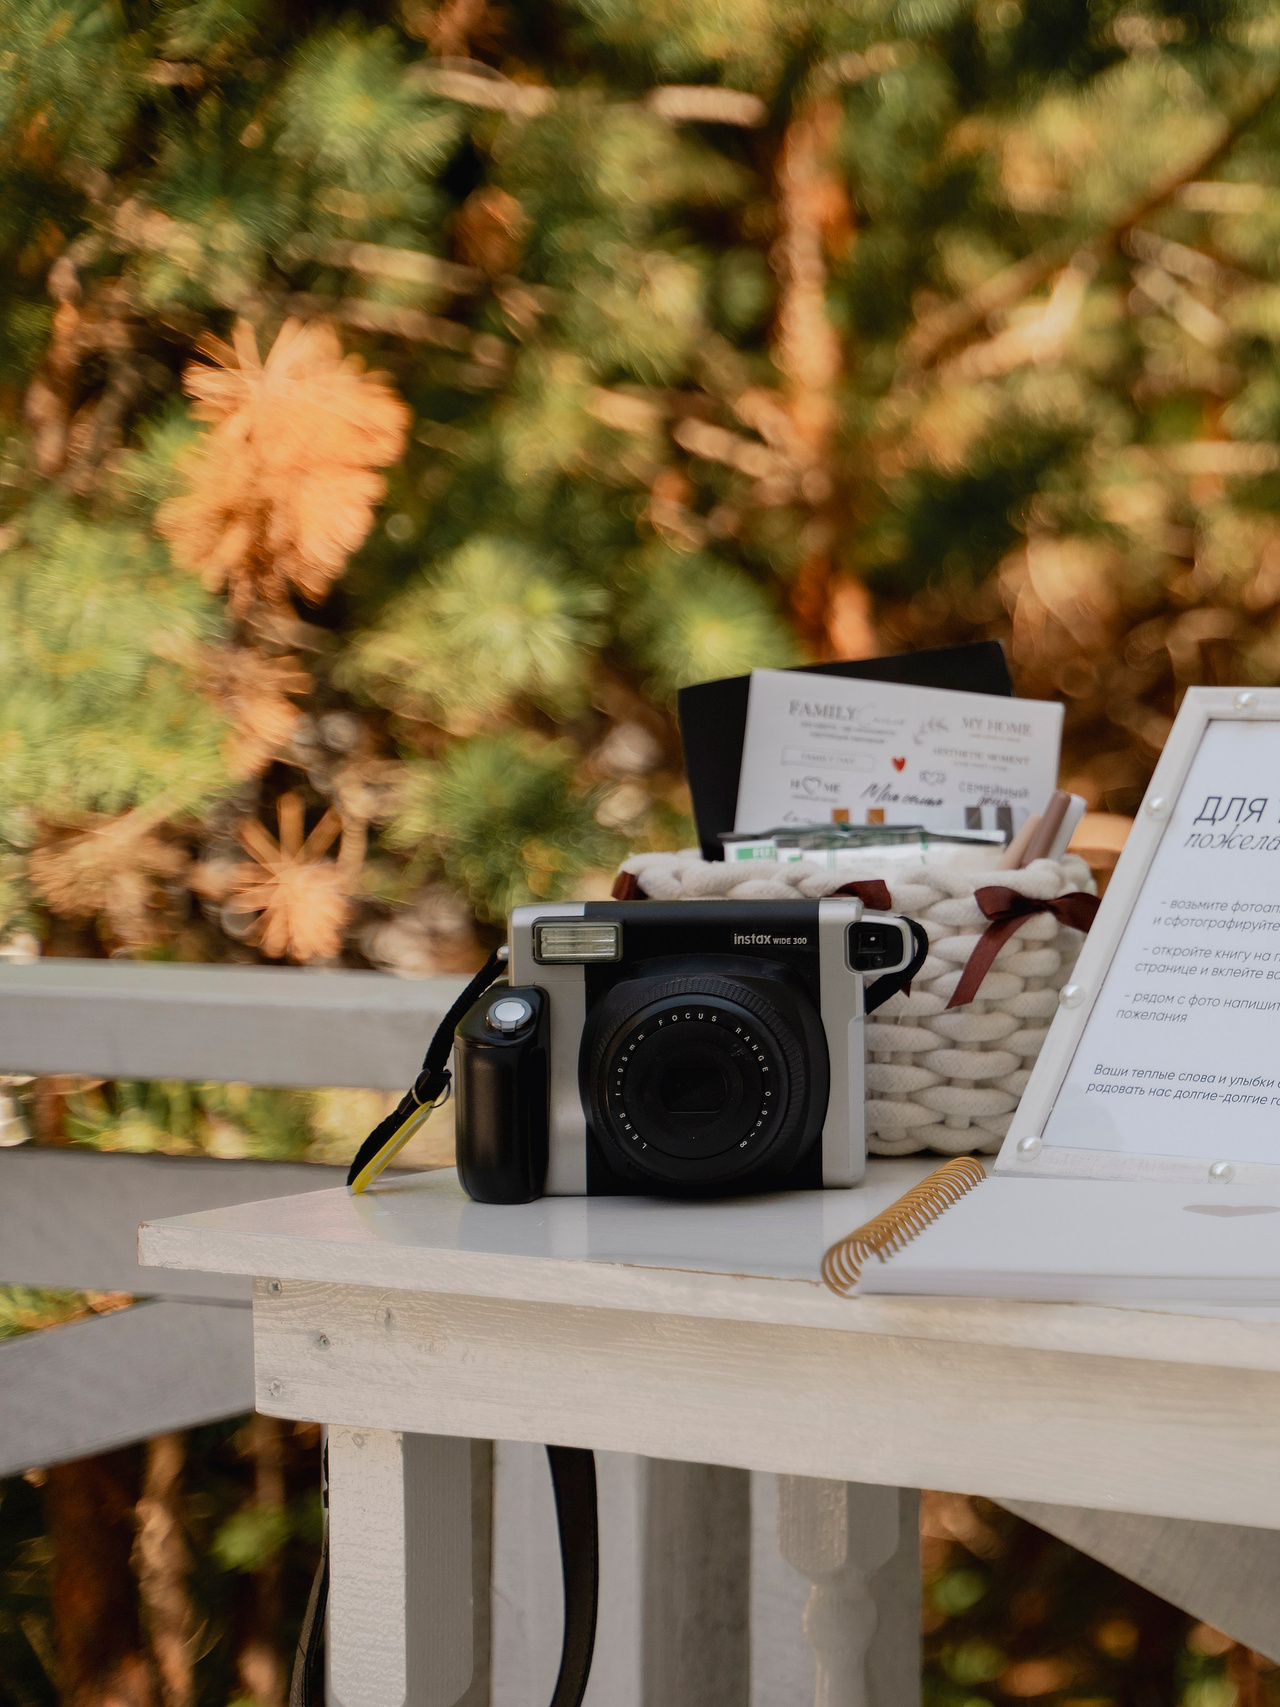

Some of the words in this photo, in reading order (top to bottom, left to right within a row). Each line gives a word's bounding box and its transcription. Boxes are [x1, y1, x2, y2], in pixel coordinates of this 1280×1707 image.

[1193, 796, 1268, 826] ДЛЯ
[1170, 900, 1229, 911] возьмите
[1152, 916, 1162, 925] и
[733, 933, 771, 945] instax
[772, 937, 791, 945] WIDE
[792, 937, 808, 945] 300
[1152, 946, 1212, 959] откройте
[1214, 950, 1251, 963] книгу
[1253, 952, 1271, 962] на
[1135, 962, 1197, 976] странице
[1200, 967, 1209, 976] и
[1211, 967, 1263, 980] вклейте
[1132, 992, 1174, 1005] рядом
[1177, 997, 1186, 1005] с
[1188, 995, 1221, 1009] фото
[1115, 1009, 1188, 1023] пожелания
[658, 1012, 718, 1027] FOCUS
[735, 1027, 769, 1073] RANGE
[1094, 1064, 1128, 1077] Ваши
[1131, 1068, 1176, 1080] теплые
[1178, 1072, 1216, 1083] слова
[1218, 1075, 1227, 1084] и
[1229, 1075, 1275, 1089] улыбки
[1086, 1082, 1146, 1095] радовать
[1149, 1087, 1172, 1097] нас
[1173, 1088, 1268, 1105] долгие-долгие
